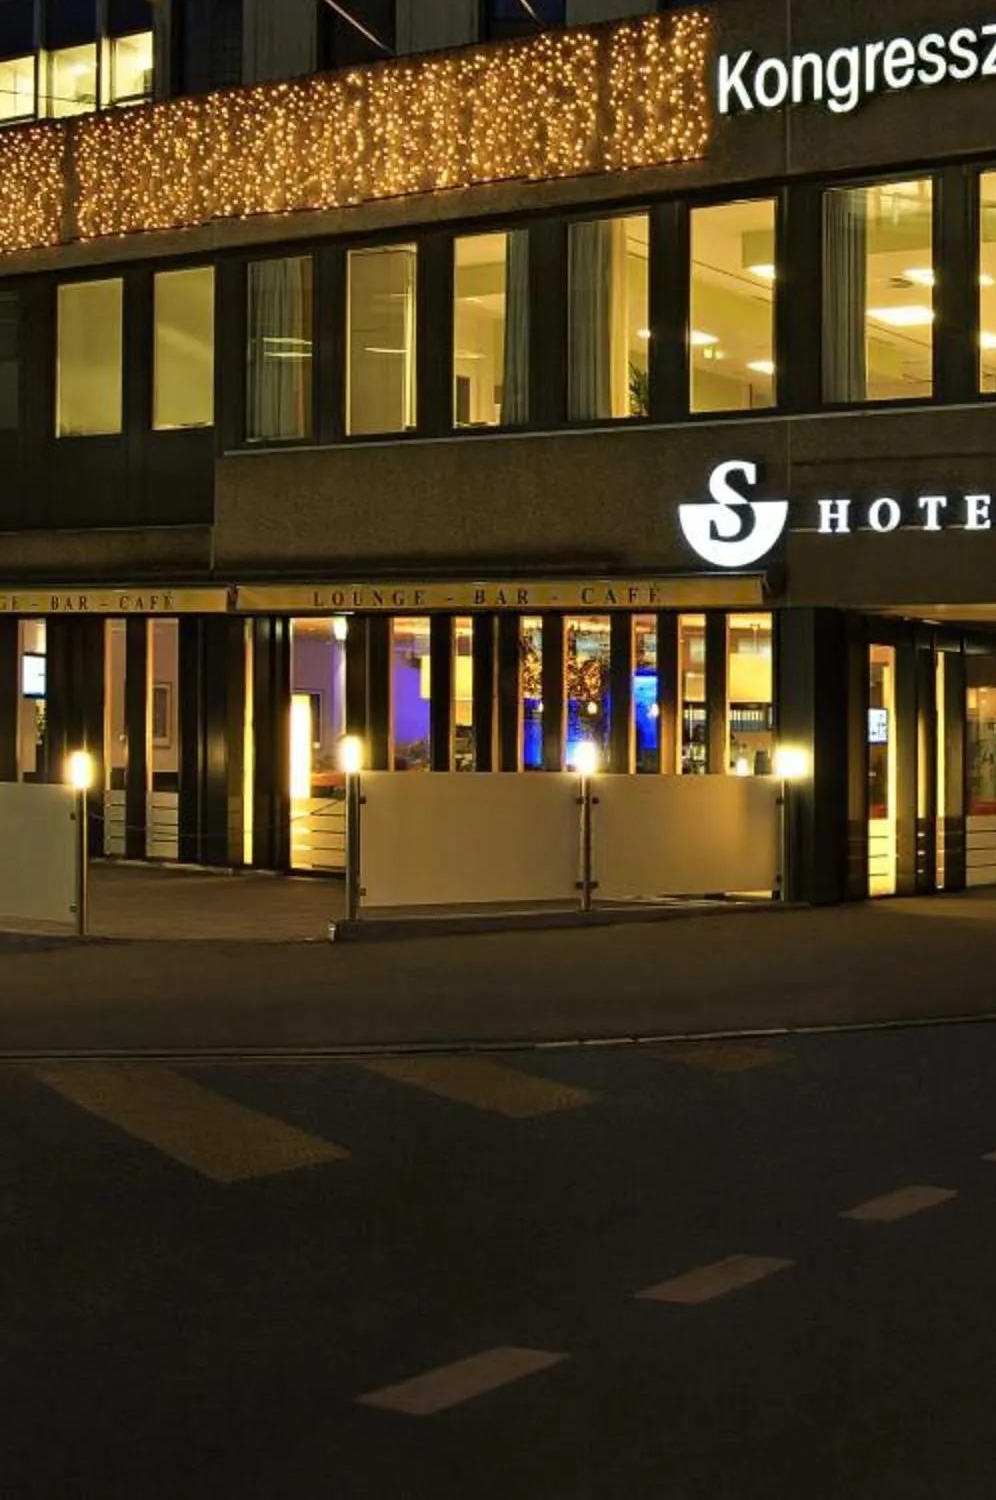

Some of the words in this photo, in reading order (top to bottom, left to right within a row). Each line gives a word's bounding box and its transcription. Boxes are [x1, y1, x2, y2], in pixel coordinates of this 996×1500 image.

[50, 595, 88, 610] BAR
[313, 589, 425, 607] LOUNGE
[473, 588, 530, 605] BAR
